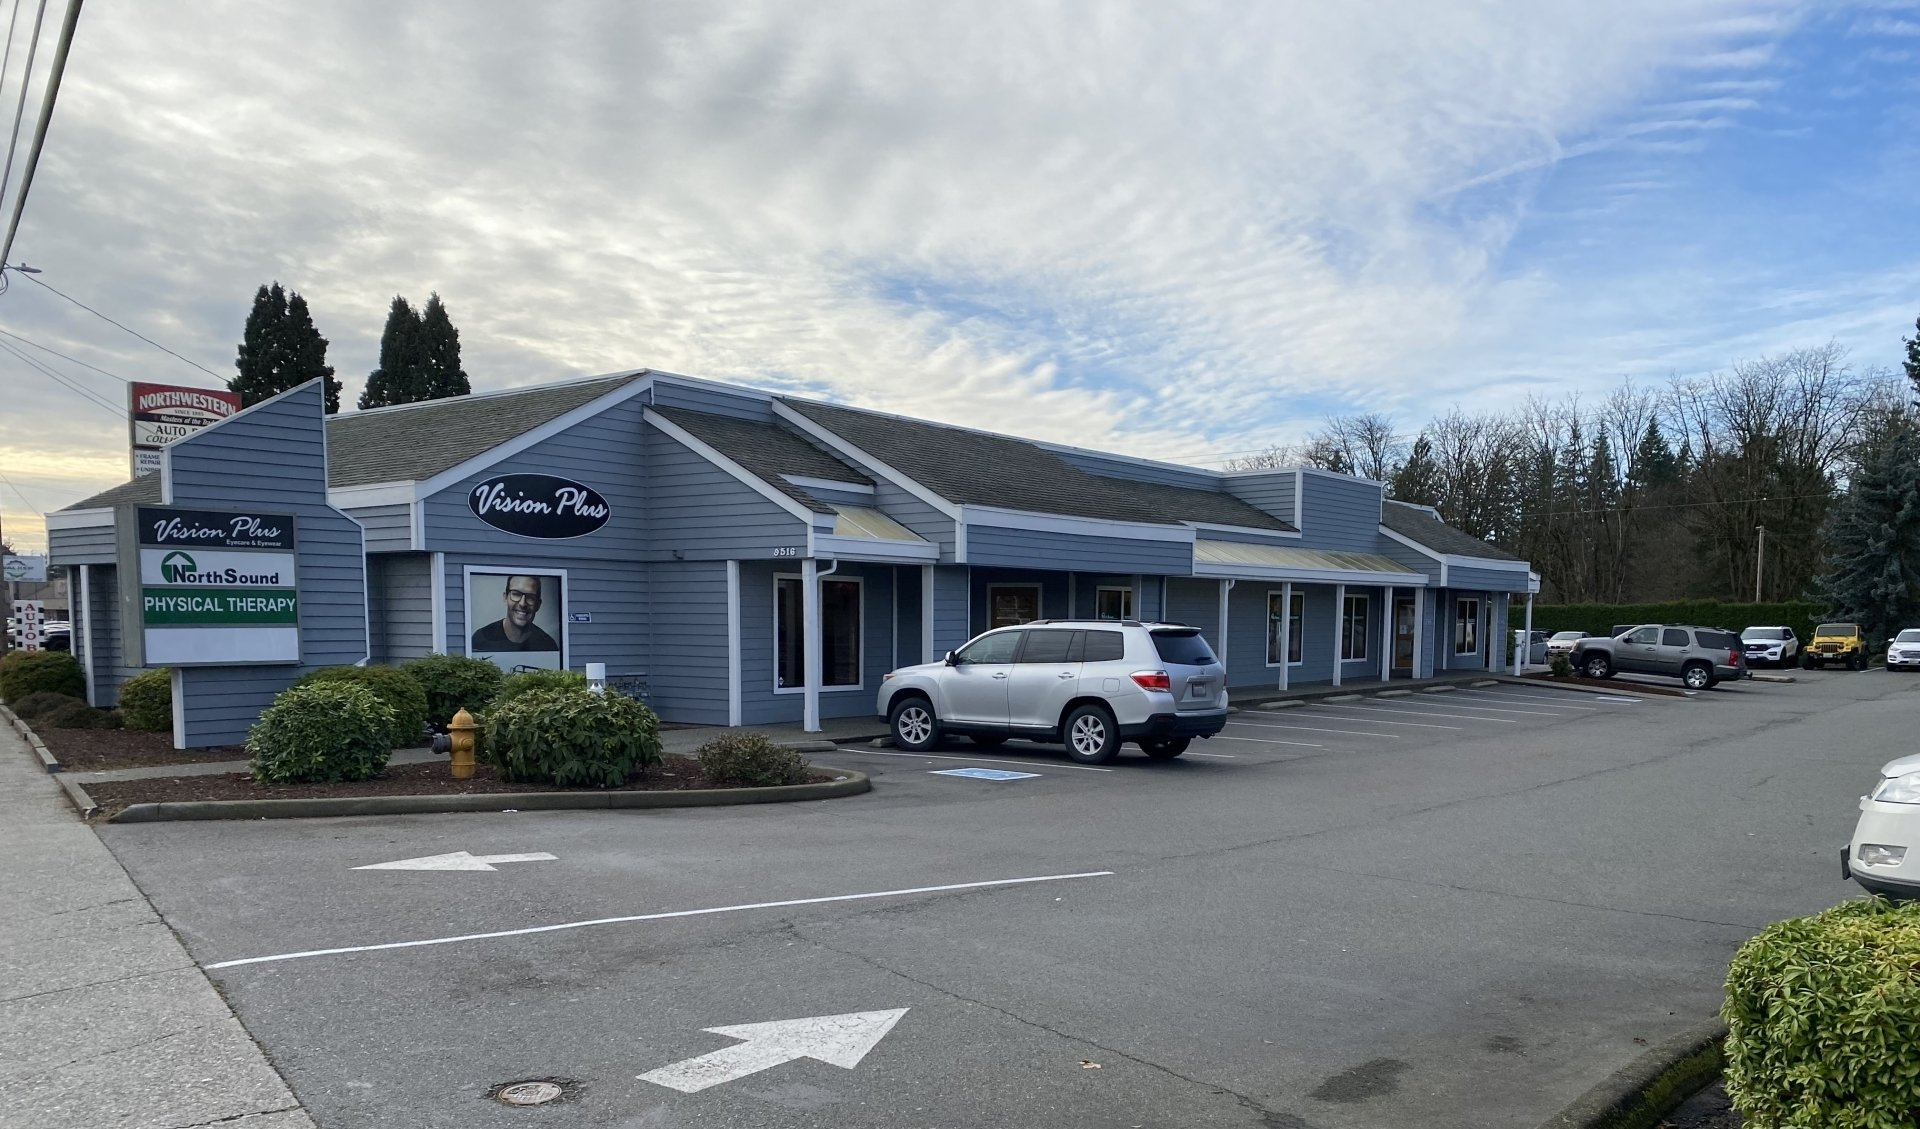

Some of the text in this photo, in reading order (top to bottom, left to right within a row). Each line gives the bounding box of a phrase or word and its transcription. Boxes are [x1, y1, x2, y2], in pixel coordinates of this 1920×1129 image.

[139, 391, 237, 417] NORTHWESTERN
[174, 408, 190, 416] SINCE
[160, 414, 184, 424] Masters
[184, 416, 192, 424] of
[192, 417, 202, 426] the
[156, 425, 187, 437] AUTO
[476, 482, 608, 518] Vision Plus
[154, 516, 281, 542] Vision Plus
[226, 538, 250, 546] Eyecare
[257, 540, 282, 548] Eyewear
[173, 564, 279, 584] NorthSound
[144, 596, 296, 612] PHYSICAL THERAPY
